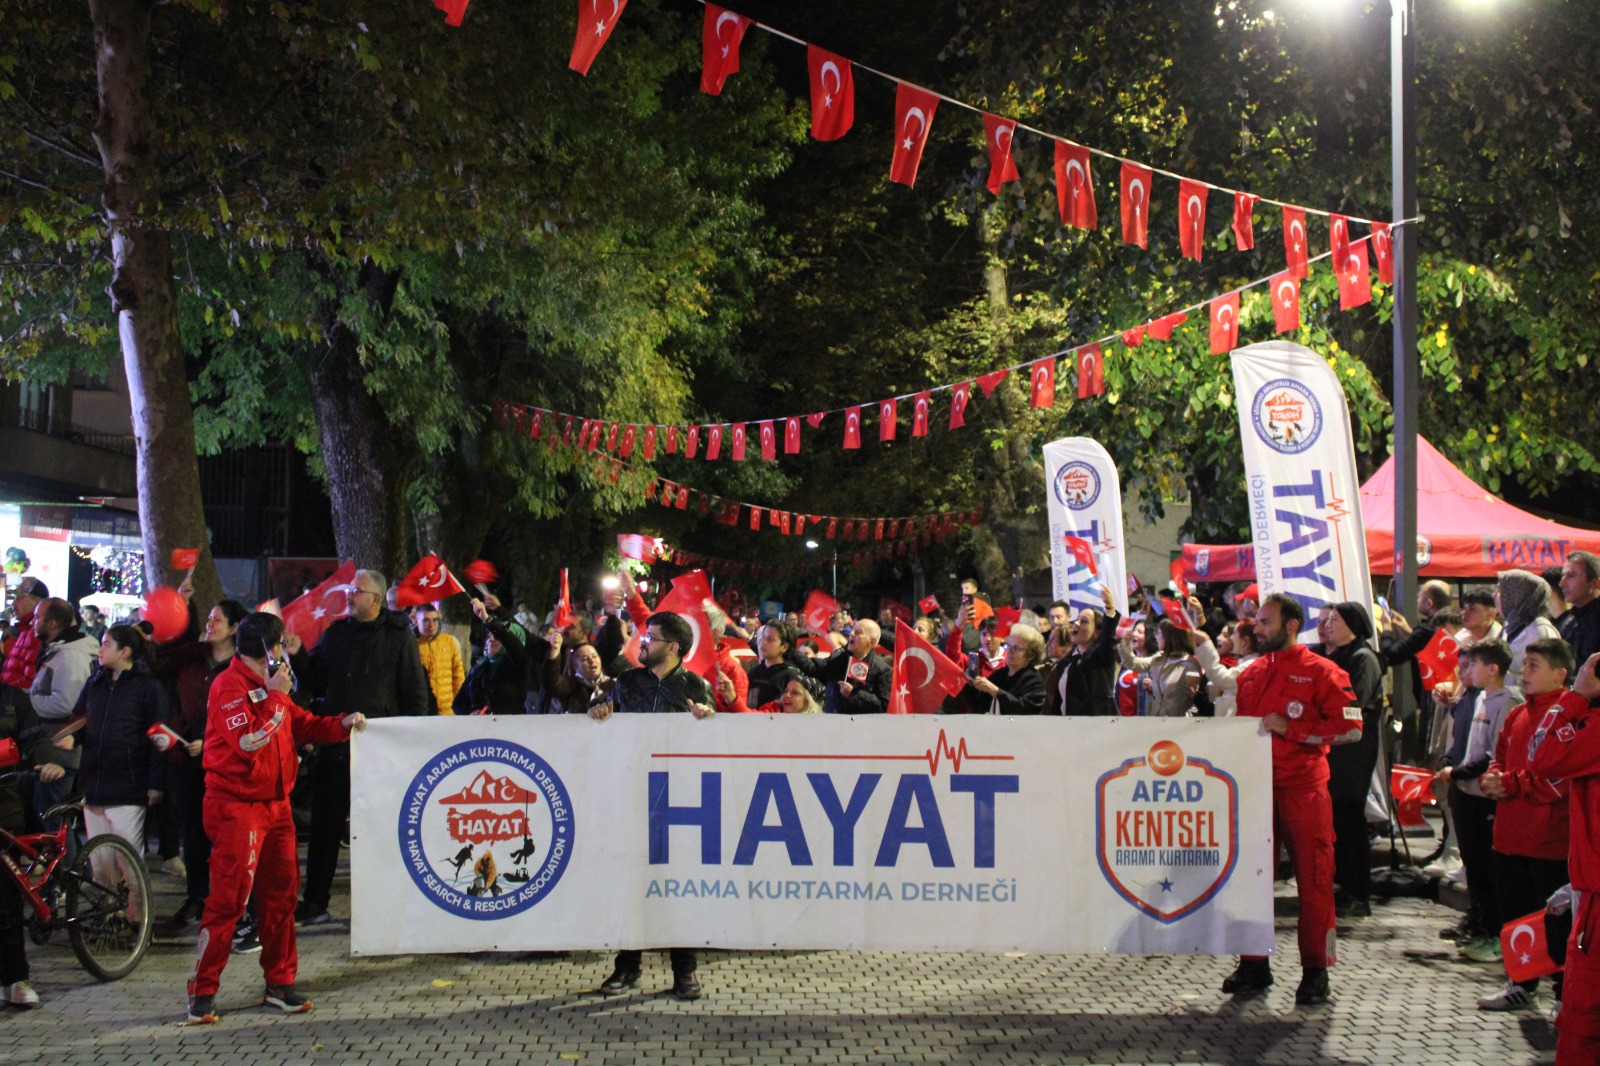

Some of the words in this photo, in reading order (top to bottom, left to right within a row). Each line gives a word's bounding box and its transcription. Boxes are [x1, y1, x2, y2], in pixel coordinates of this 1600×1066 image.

[1489, 539, 1569, 564] HAYAT
[408, 783, 428, 824] HAYAT
[426, 751, 468, 785] ARAMA
[469, 746, 536, 774] KURTARMA
[535, 769, 568, 822] DERNEĞİ
[1131, 780, 1204, 803] AFAD
[458, 819, 522, 835] HAYAT
[648, 771, 1019, 868] HAYAT
[1116, 810, 1220, 848] KENTSEL
[1116, 849, 1156, 866] ARAMA
[1159, 849, 1220, 866] KURTARMA
[408, 840, 428, 875] HAYAT
[423, 874, 462, 907] SEARCH
[462, 899, 471, 910] &
[474, 896, 518, 912] RESCUE
[519, 838, 566, 902] ASSOCIATION
[645, 879, 740, 899] ARAMA
[748, 880, 894, 901] KURTARMA
[901, 878, 1018, 902] DERNEĞİ
